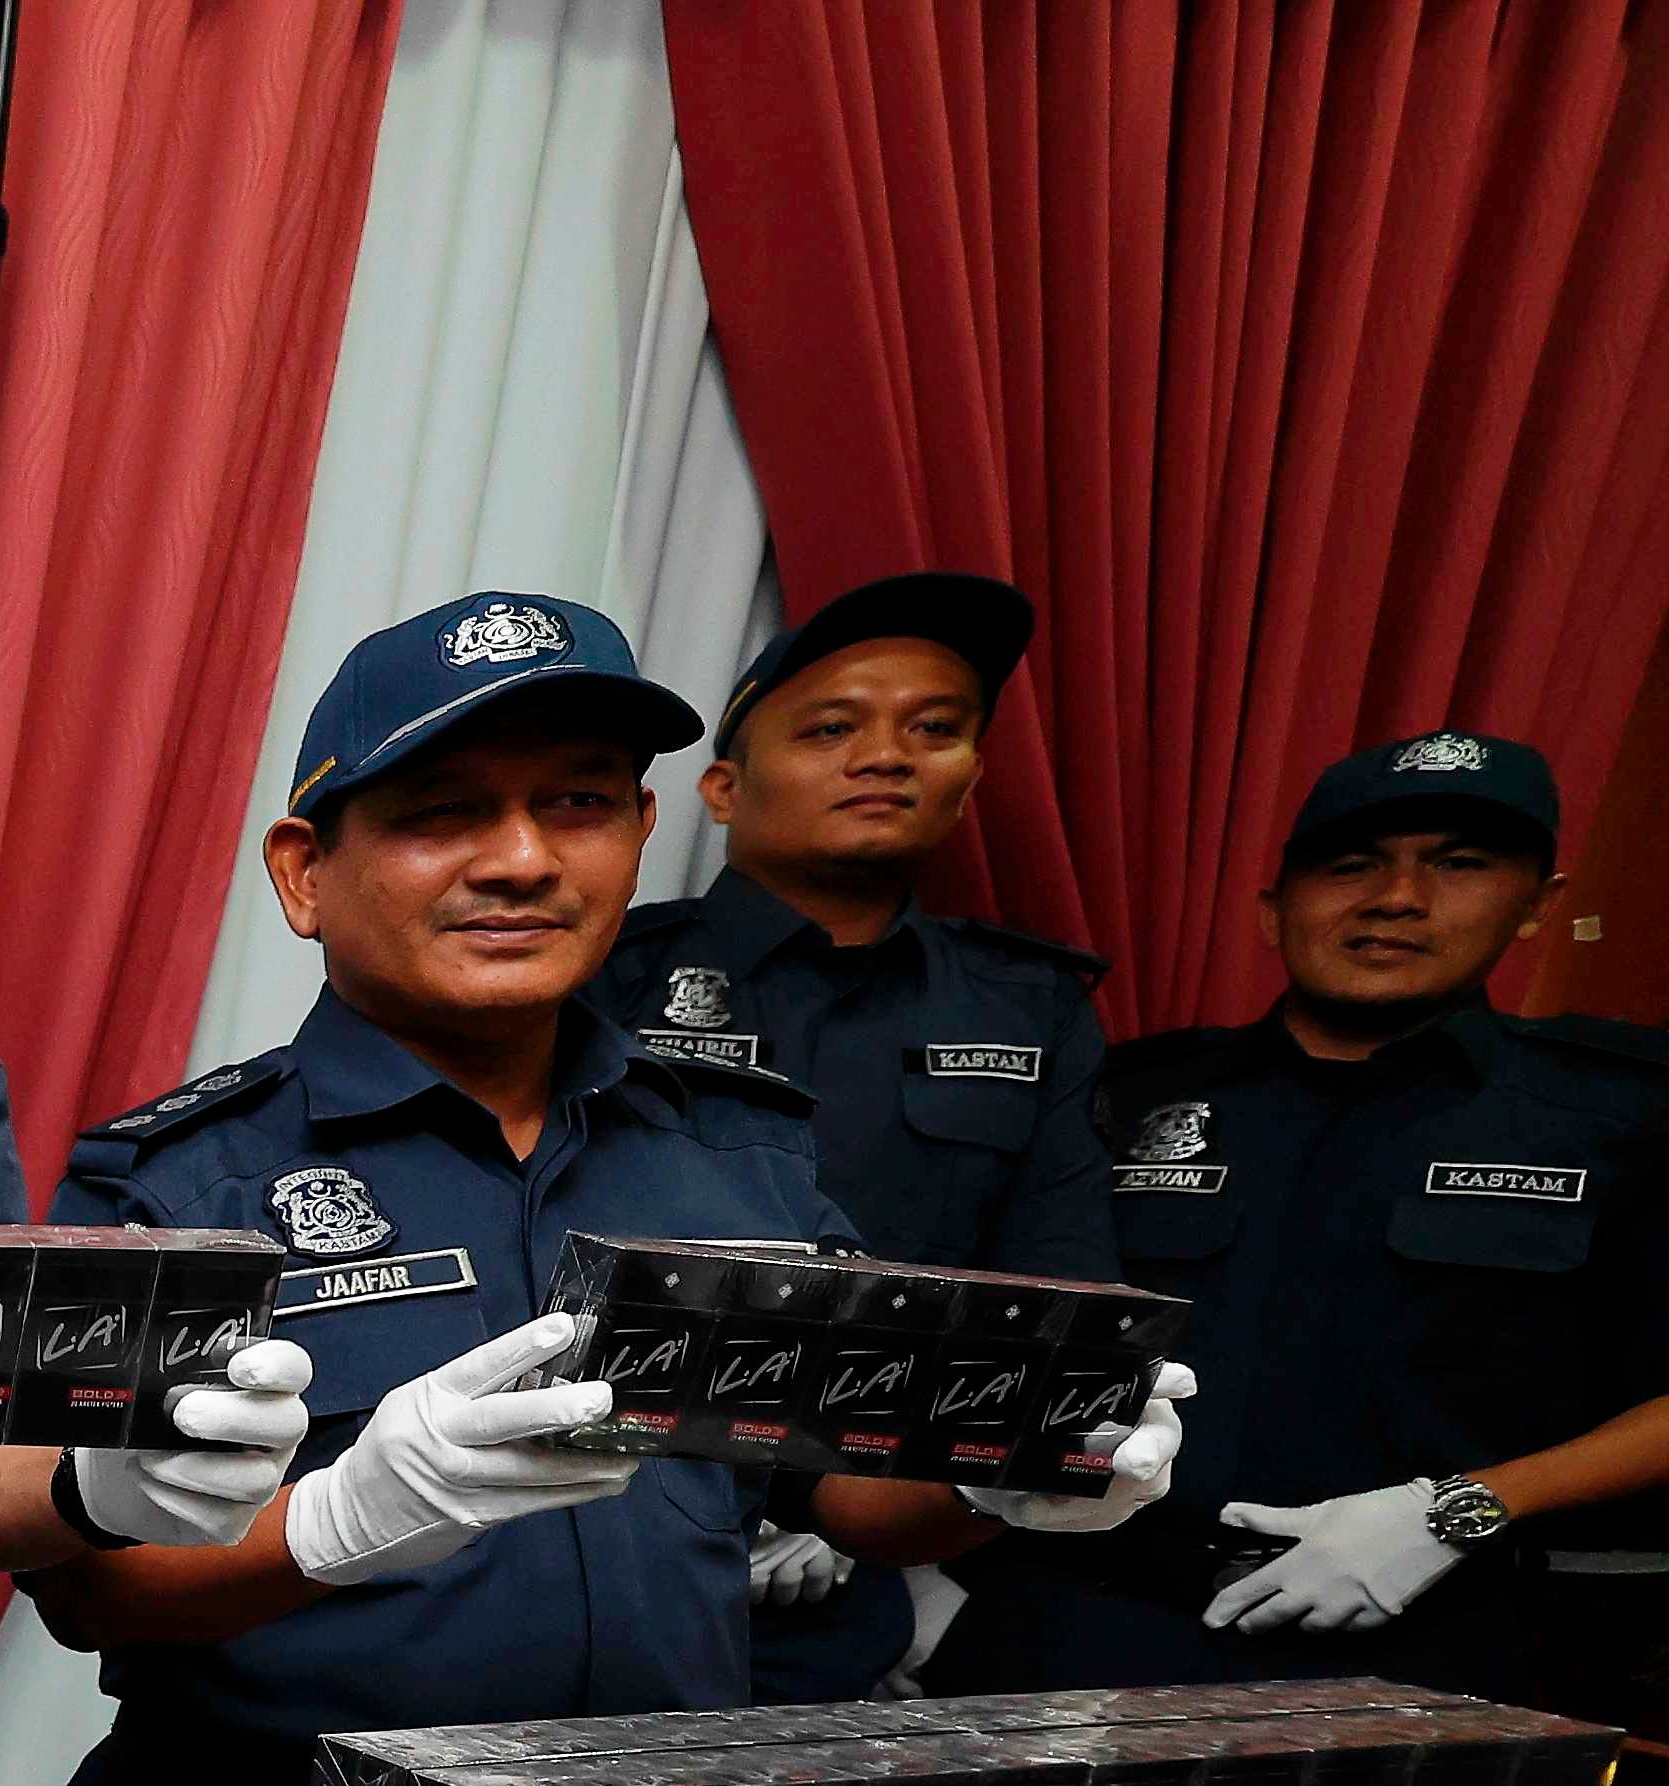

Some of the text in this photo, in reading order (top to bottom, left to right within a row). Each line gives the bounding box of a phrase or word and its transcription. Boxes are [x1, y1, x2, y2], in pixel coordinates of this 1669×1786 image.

[939, 1048, 1030, 1073] KASTAM
[1120, 1170, 1203, 1187] AZWAN
[1445, 1167, 1567, 1195] KASTAM
[316, 1266, 411, 1298] JAAFAR
[72, 1389, 114, 1401] BOLD
[733, 1424, 772, 1436] BOLD
[844, 1434, 884, 1445] BOLD
[954, 1445, 993, 1456] BOLD
[1065, 1455, 1102, 1466] BOLD
